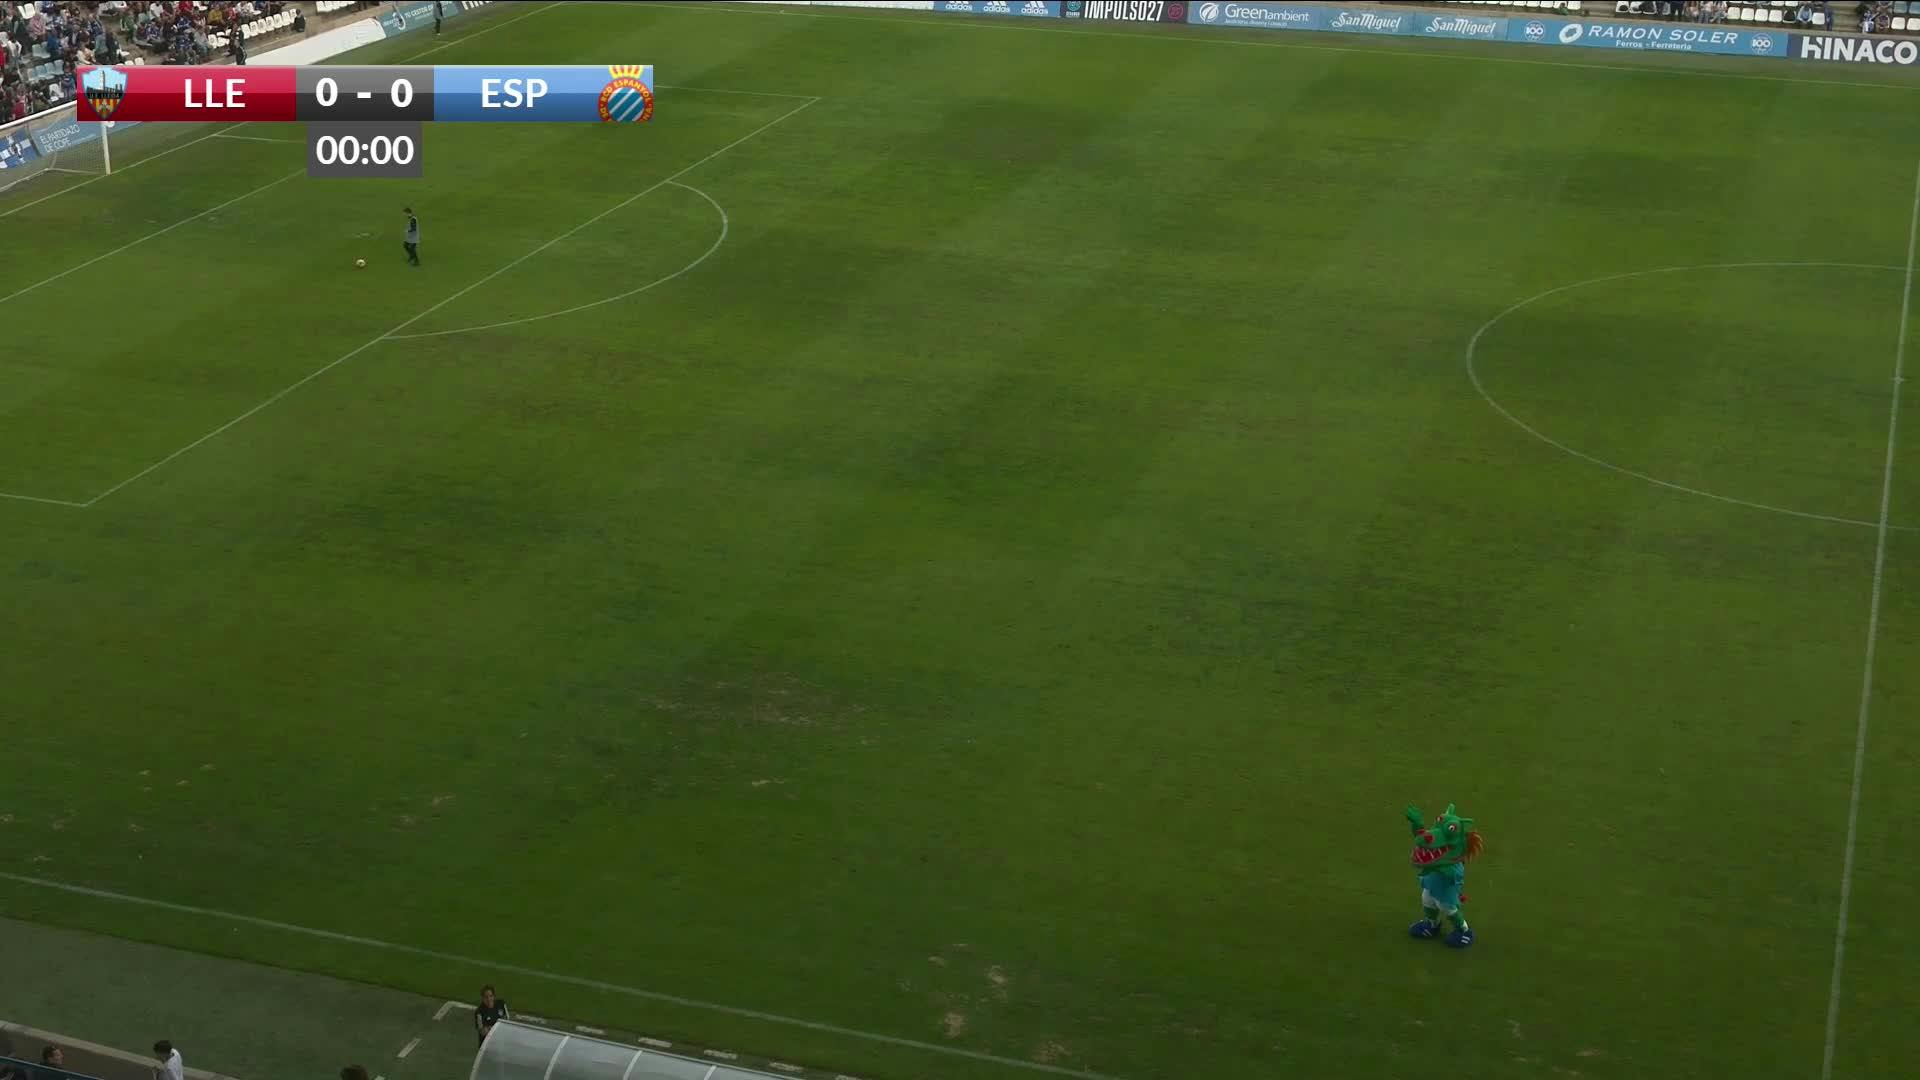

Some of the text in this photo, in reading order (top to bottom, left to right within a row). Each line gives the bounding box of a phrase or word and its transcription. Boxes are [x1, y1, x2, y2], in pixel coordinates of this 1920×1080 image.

[983, 5, 1010, 13] adidas
[1021, 7, 1049, 15] adidas
[1084, 1, 1164, 21] IMPULSO27
[1588, 25, 1663, 40] RAMON
[1669, 29, 1739, 45] SOLER
[1615, 40, 1643, 48] Ferros
[1651, 41, 1692, 50] Ferreteria
[1800, 36, 1918, 64] HINACO
